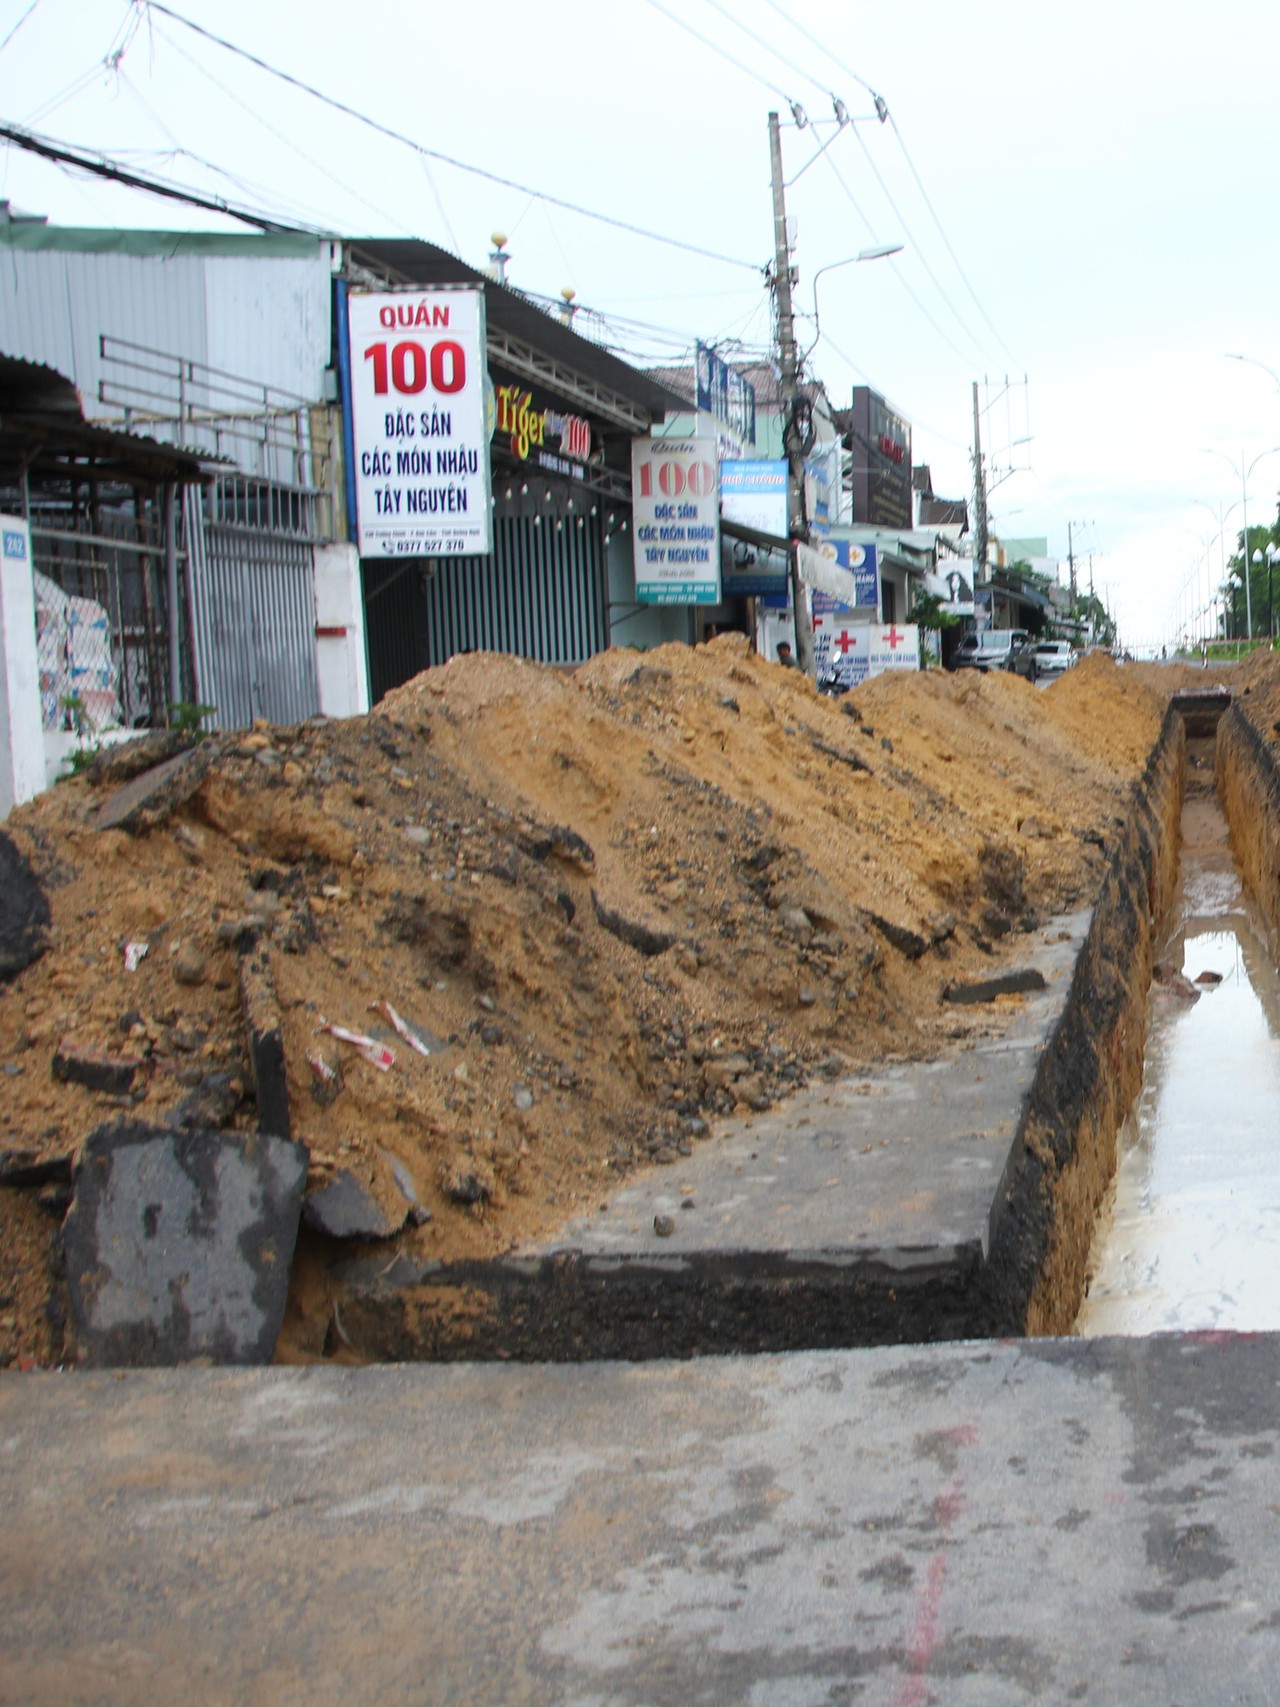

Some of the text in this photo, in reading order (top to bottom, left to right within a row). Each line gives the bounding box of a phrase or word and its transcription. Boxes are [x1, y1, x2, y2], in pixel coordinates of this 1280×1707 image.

[379, 297, 450, 331] QUÁN
[364, 340, 466, 396] 100
[385, 402, 451, 444] ĐẶC SẢN
[497, 385, 545, 460] Tiger
[562, 414, 591, 462] 100
[361, 443, 478, 480] CÁC MÓN NHẬU
[640, 461, 715, 498] 100
[374, 481, 468, 513] TÂY NGUYÊN
[638, 522, 658, 541] CÁC
[660, 522, 686, 541] MÓN
[645, 546, 667, 563] TÂY
